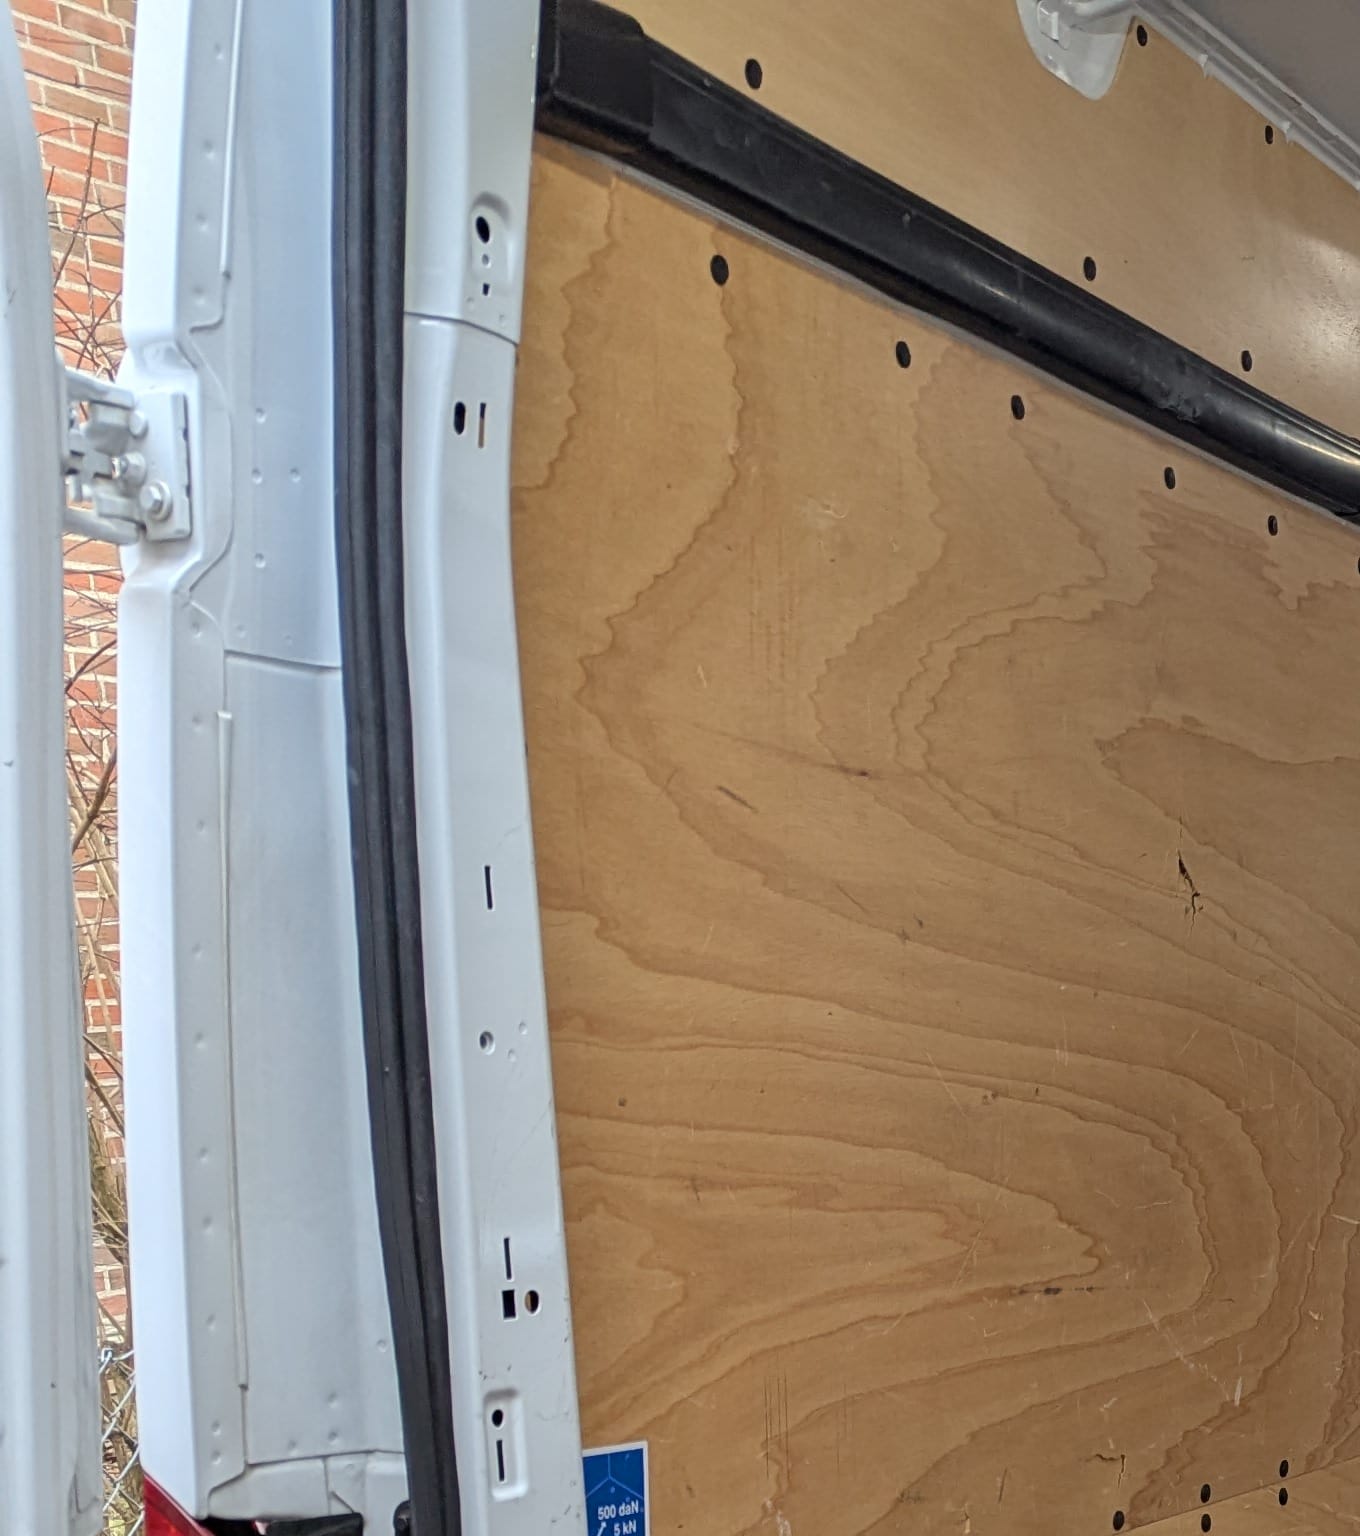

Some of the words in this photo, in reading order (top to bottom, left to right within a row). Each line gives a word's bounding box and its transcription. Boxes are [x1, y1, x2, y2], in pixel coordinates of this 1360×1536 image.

[597, 1504, 616, 1520] 500
[618, 1499, 639, 1517] daN
[613, 1522, 621, 1536] 5
[622, 1519, 637, 1535] kN
